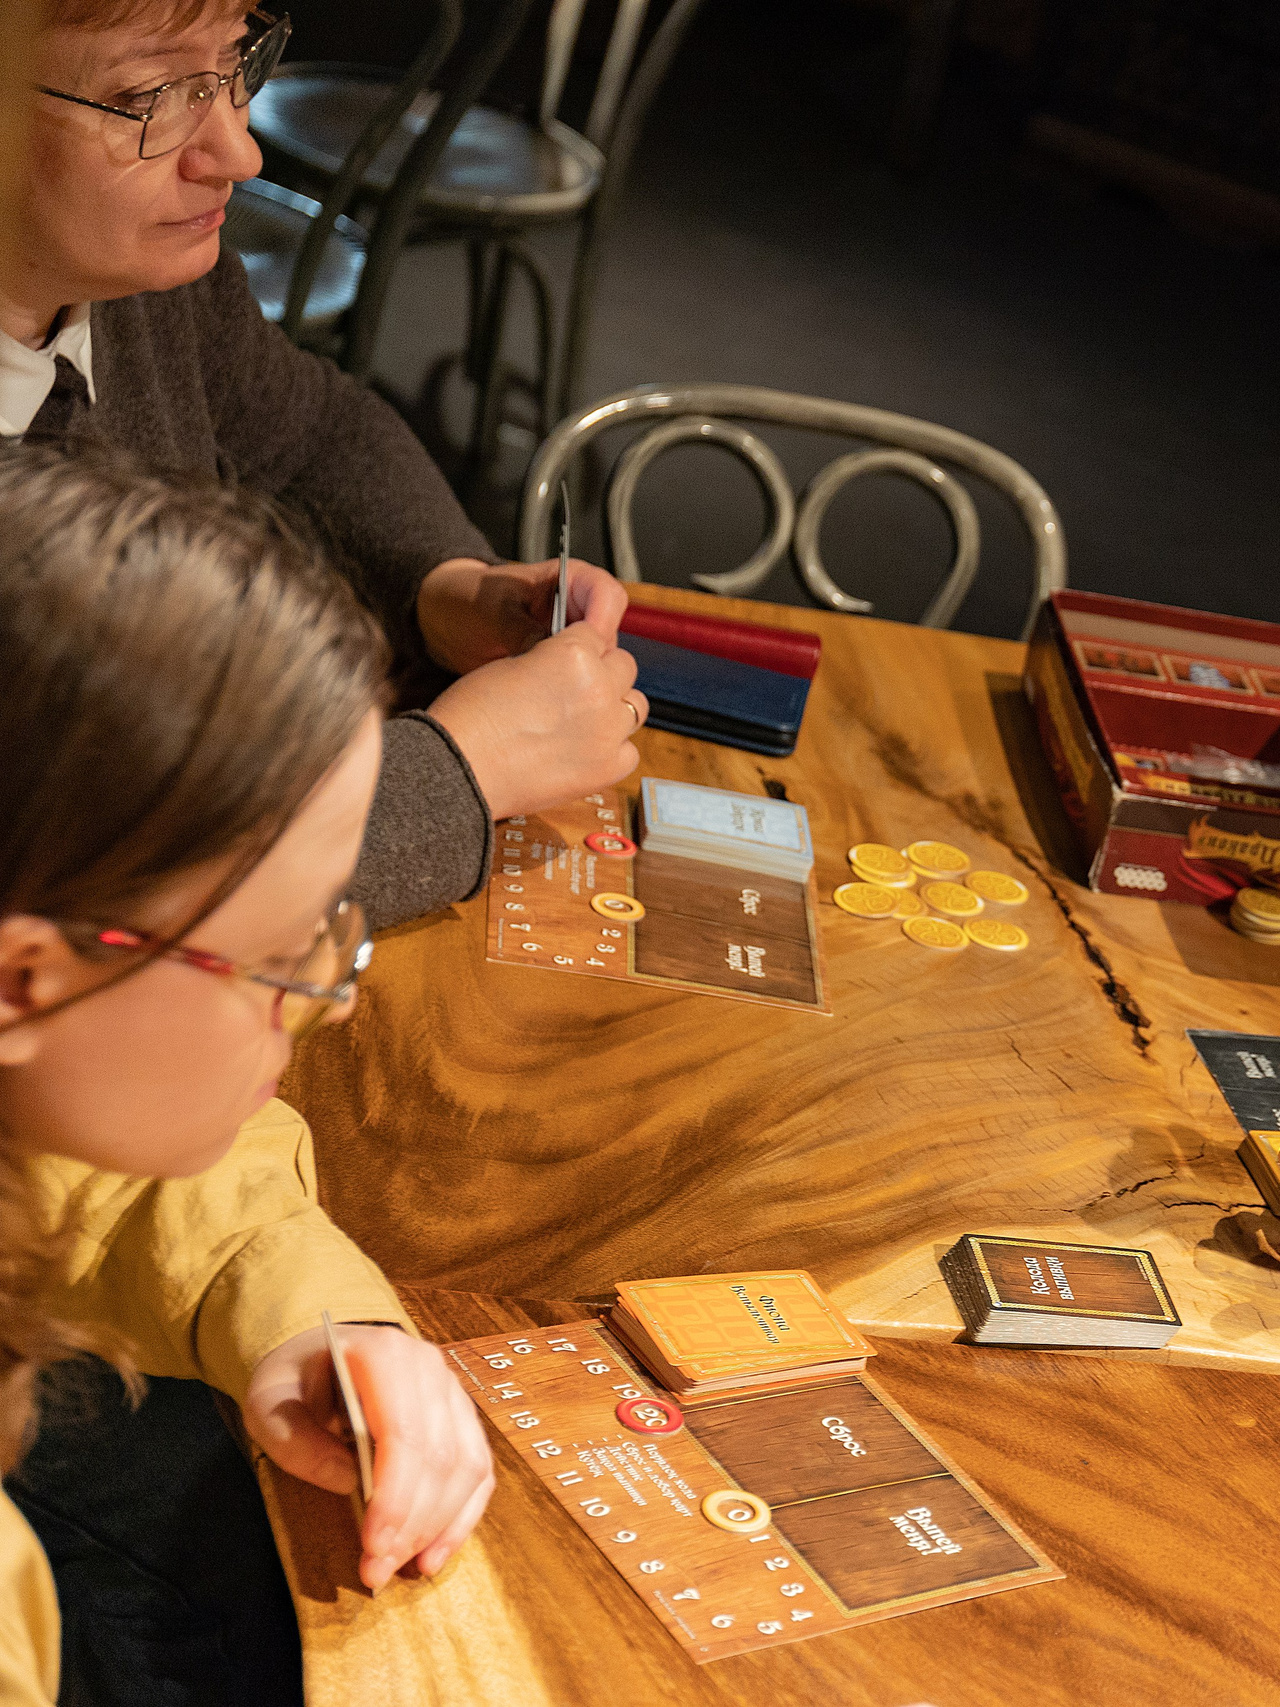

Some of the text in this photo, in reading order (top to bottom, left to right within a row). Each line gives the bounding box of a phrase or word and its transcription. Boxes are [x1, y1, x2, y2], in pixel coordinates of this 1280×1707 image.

[503, 884, 524, 893] 9
[505, 902, 525, 911] 8
[739, 888, 761, 916] Сброс
[510, 923, 531, 932] 7
[602, 928, 622, 938] 2
[522, 942, 543, 951] 6
[596, 943, 616, 953] 3
[554, 955, 574, 965] 5
[586, 957, 605, 967] 4
[1023, 1257, 1050, 1295] Колода
[1045, 1256, 1075, 1300] выпивки
[729, 1285, 780, 1344] Вспыльчивая
[759, 1295, 790, 1331] Фиона
[507, 1338, 537, 1354] 16
[547, 1338, 578, 1352] 17
[483, 1353, 514, 1370] 15
[581, 1359, 610, 1375] 18
[492, 1382, 523, 1399] 14
[612, 1383, 642, 1399] 19
[510, 1411, 540, 1429] 13
[634, 1407, 668, 1427] 20
[821, 1416, 867, 1457] Сброс
[532, 1440, 562, 1458] 12
[592, 1447, 618, 1472] Заказ
[555, 1470, 583, 1487] 11
[622, 1441, 647, 1465] Сброс
[647, 1474, 676, 1498] добор
[670, 1498, 693, 1517] карт
[642, 1443, 698, 1500] Порядок хода
[579, 1497, 610, 1517] 10
[727, 1509, 751, 1521] 0
[611, 1530, 637, 1543] 9
[749, 1534, 770, 1543] 1
[889, 1515, 942, 1555] меня!
[904, 1507, 963, 1555] Выпей
[640, 1560, 665, 1574] 8
[764, 1556, 790, 1571] 2
[672, 1588, 700, 1600] 7
[780, 1583, 804, 1597] 3
[711, 1615, 735, 1628] 6
[791, 1609, 813, 1622] 4
[757, 1621, 783, 1634] 5
